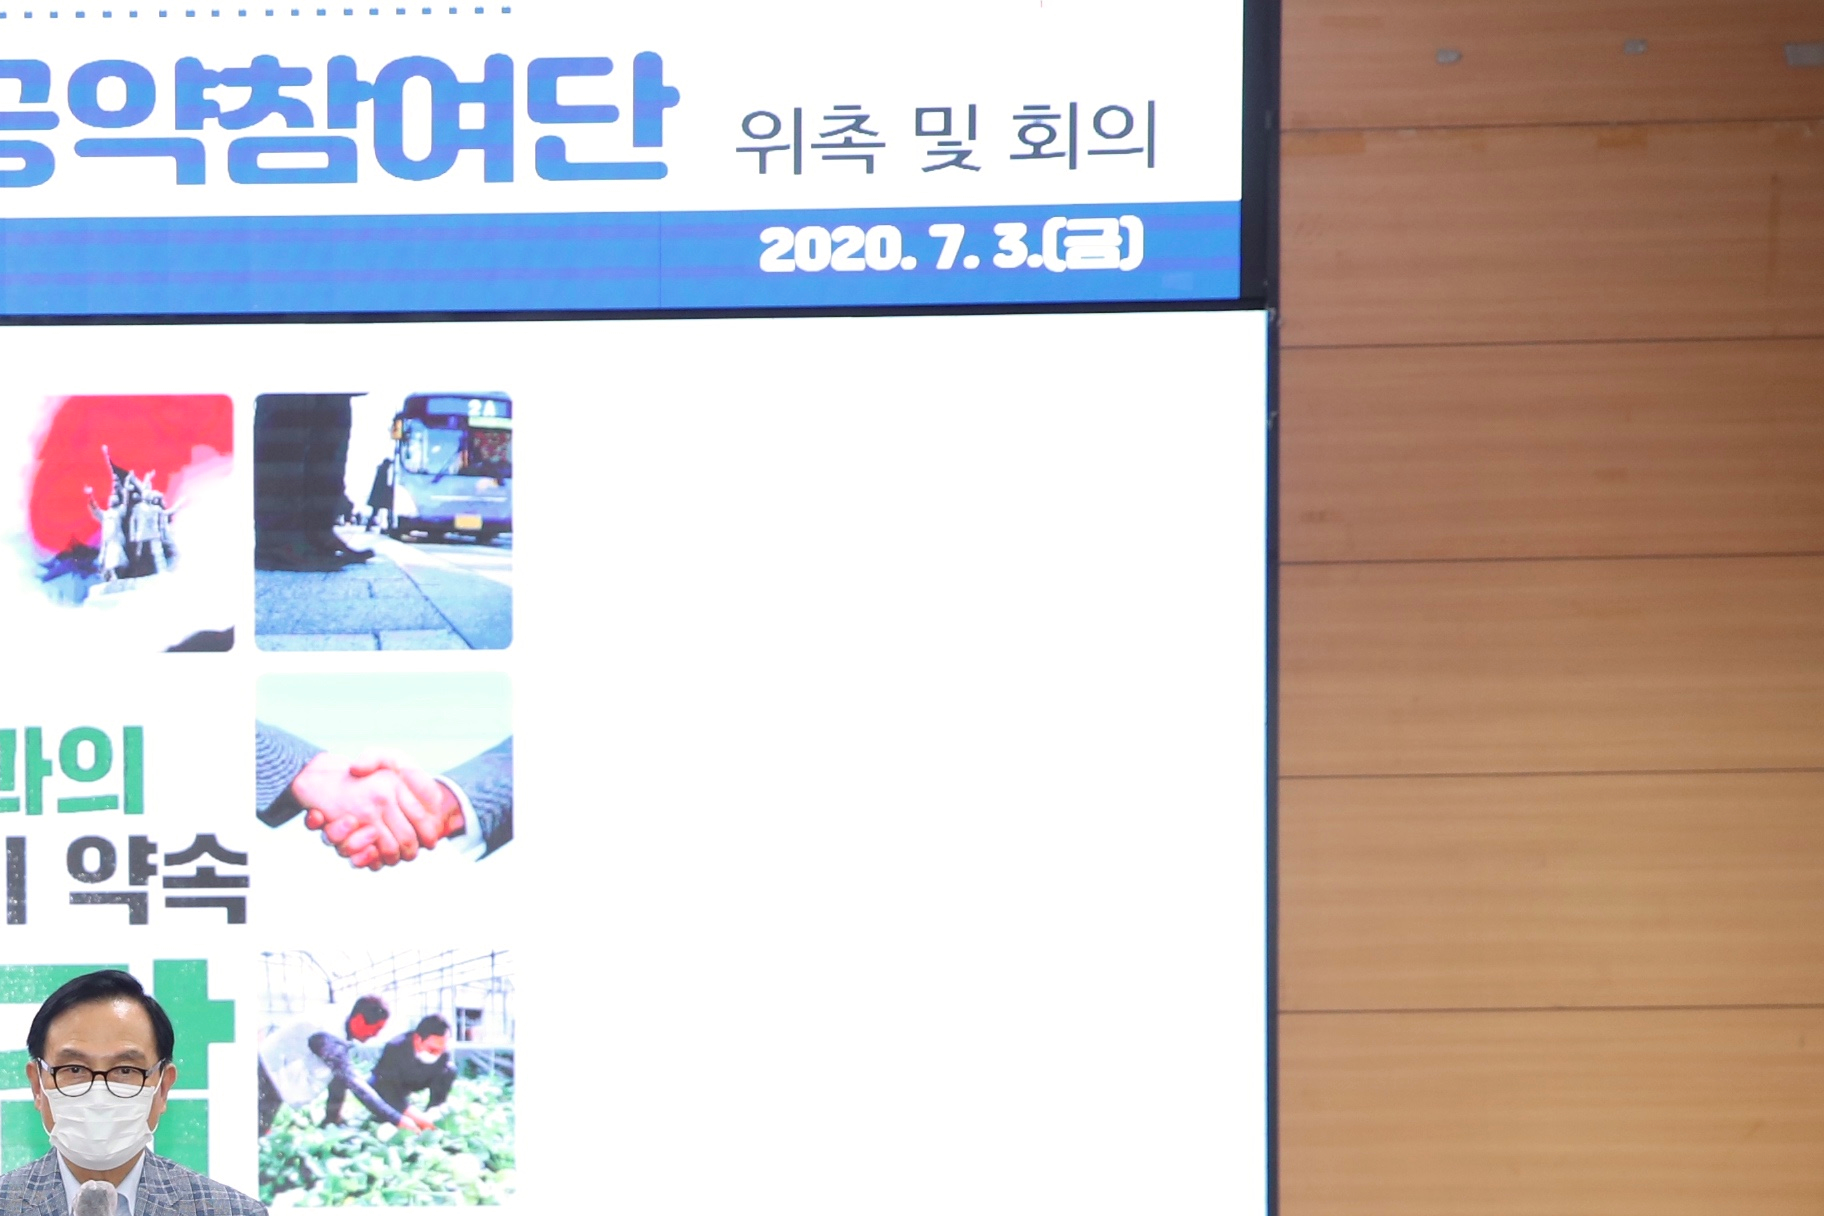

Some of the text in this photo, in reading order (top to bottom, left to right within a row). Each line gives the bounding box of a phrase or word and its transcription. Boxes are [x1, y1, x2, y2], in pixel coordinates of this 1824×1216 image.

[736, 105, 886, 175] 위촉
[915, 104, 981, 173] 및
[1010, 100, 1155, 170] 회의
[760, 225, 916, 272] 2020.
[929, 224, 979, 269] 7.
[66, 833, 250, 925] 약속
